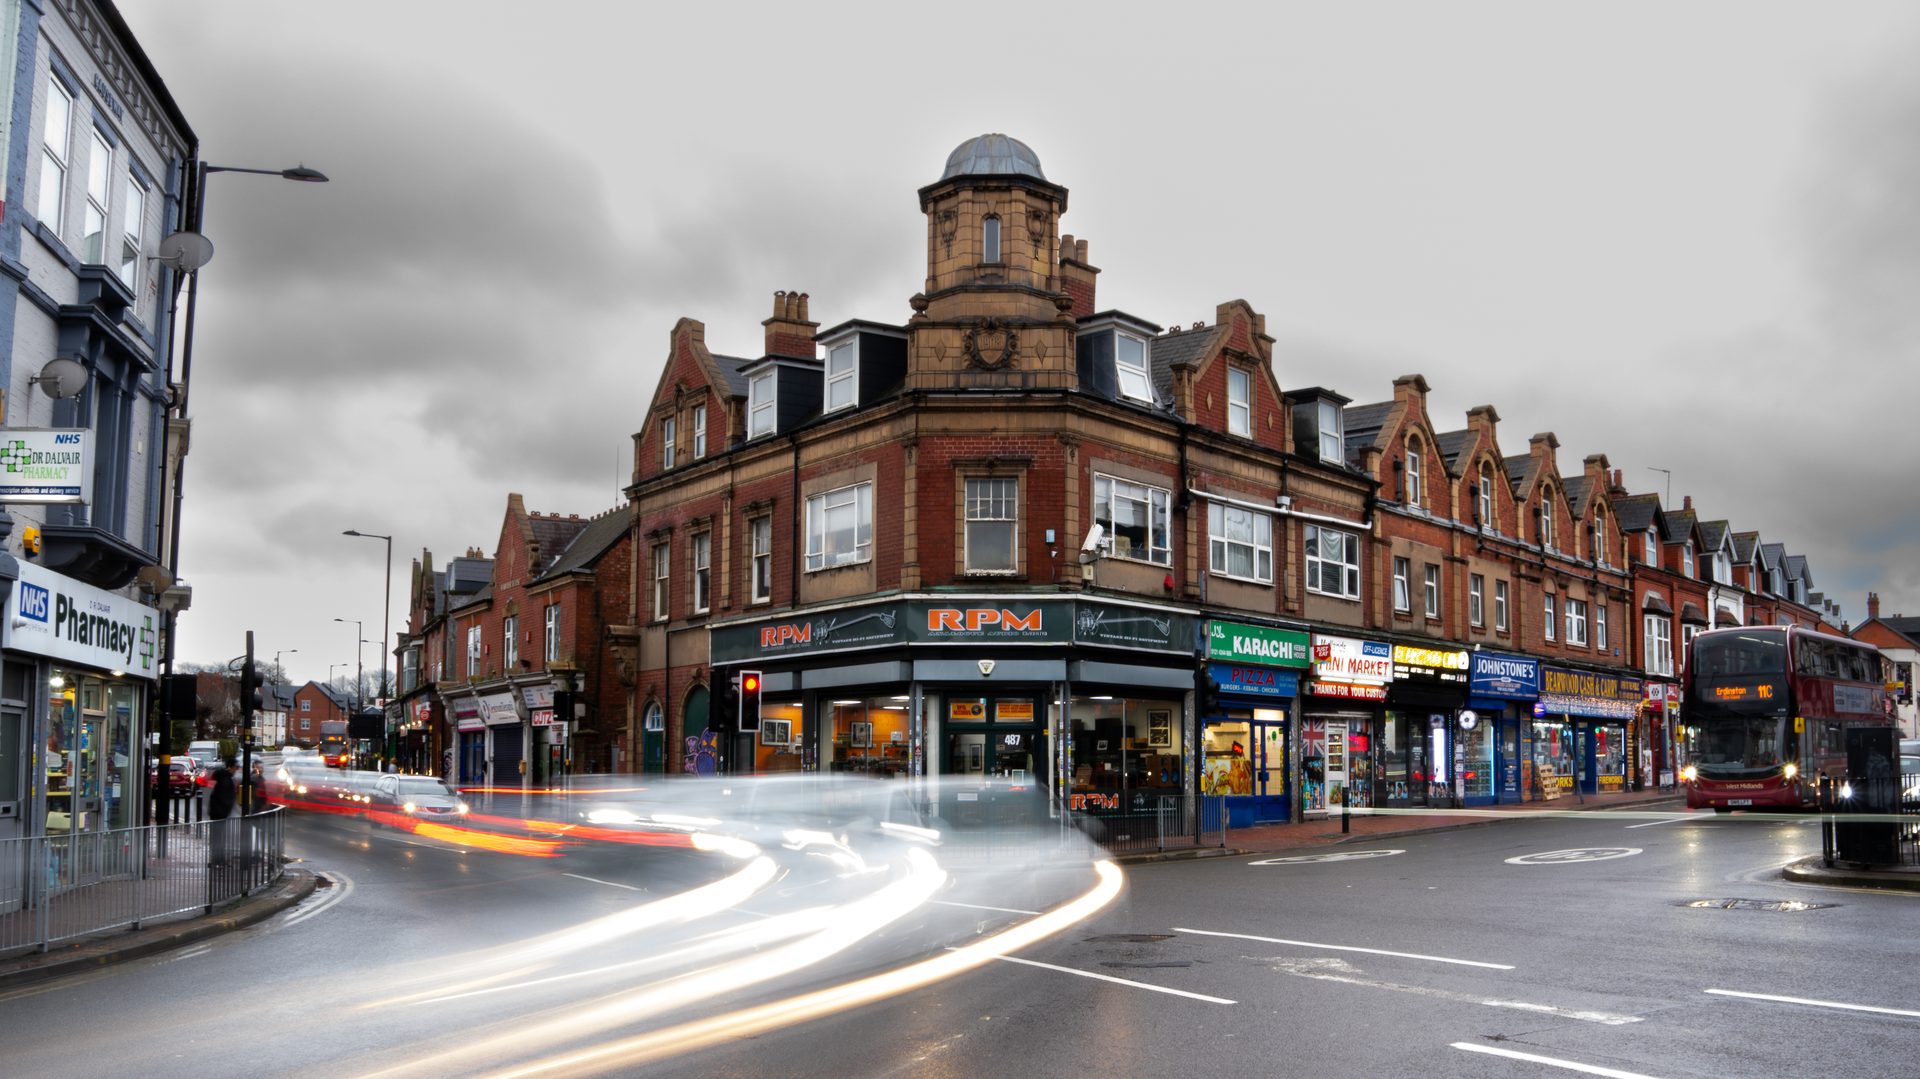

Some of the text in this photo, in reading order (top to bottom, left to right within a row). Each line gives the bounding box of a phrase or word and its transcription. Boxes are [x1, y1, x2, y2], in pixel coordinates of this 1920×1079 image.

[55, 434, 80, 444] NHS
[32, 452, 81, 465] DR DALVAIR
[23, 466, 69, 479] PHARMACY
[49, 487, 64, 495] delivery
[21, 585, 47, 618] NHS
[927, 608, 1042, 631] RPM
[55, 592, 136, 665] Pharmacy
[761, 622, 812, 648] RPM
[1233, 635, 1293, 660] KARACHI
[1294, 644, 1306, 652] KEBAB
[1363, 645, 1388, 656] OFF-LICENCE
[1294, 652, 1306, 660] HOUSE
[1347, 657, 1389, 676] MARKET
[1476, 659, 1534, 678] JOHNSTONE'S
[1231, 667, 1276, 686] PIZZA
[1220, 683, 1240, 691] BURGERS
[1314, 683, 1337, 695] THANKS
[1337, 685, 1348, 696] FOR
[1350, 686, 1366, 697] YOUR
[1545, 670, 1579, 694] BEARWOOD
[1579, 674, 1594, 696] CASH
[1600, 678, 1617, 698] CARRY
[1716, 684, 1773, 698] Erdington 11C
[1004, 734, 1021, 746] 487
[1599, 775, 1624, 784] FIREWORKS
[1740, 782, 1764, 790] Midlands
[1070, 793, 1119, 811] RPM
